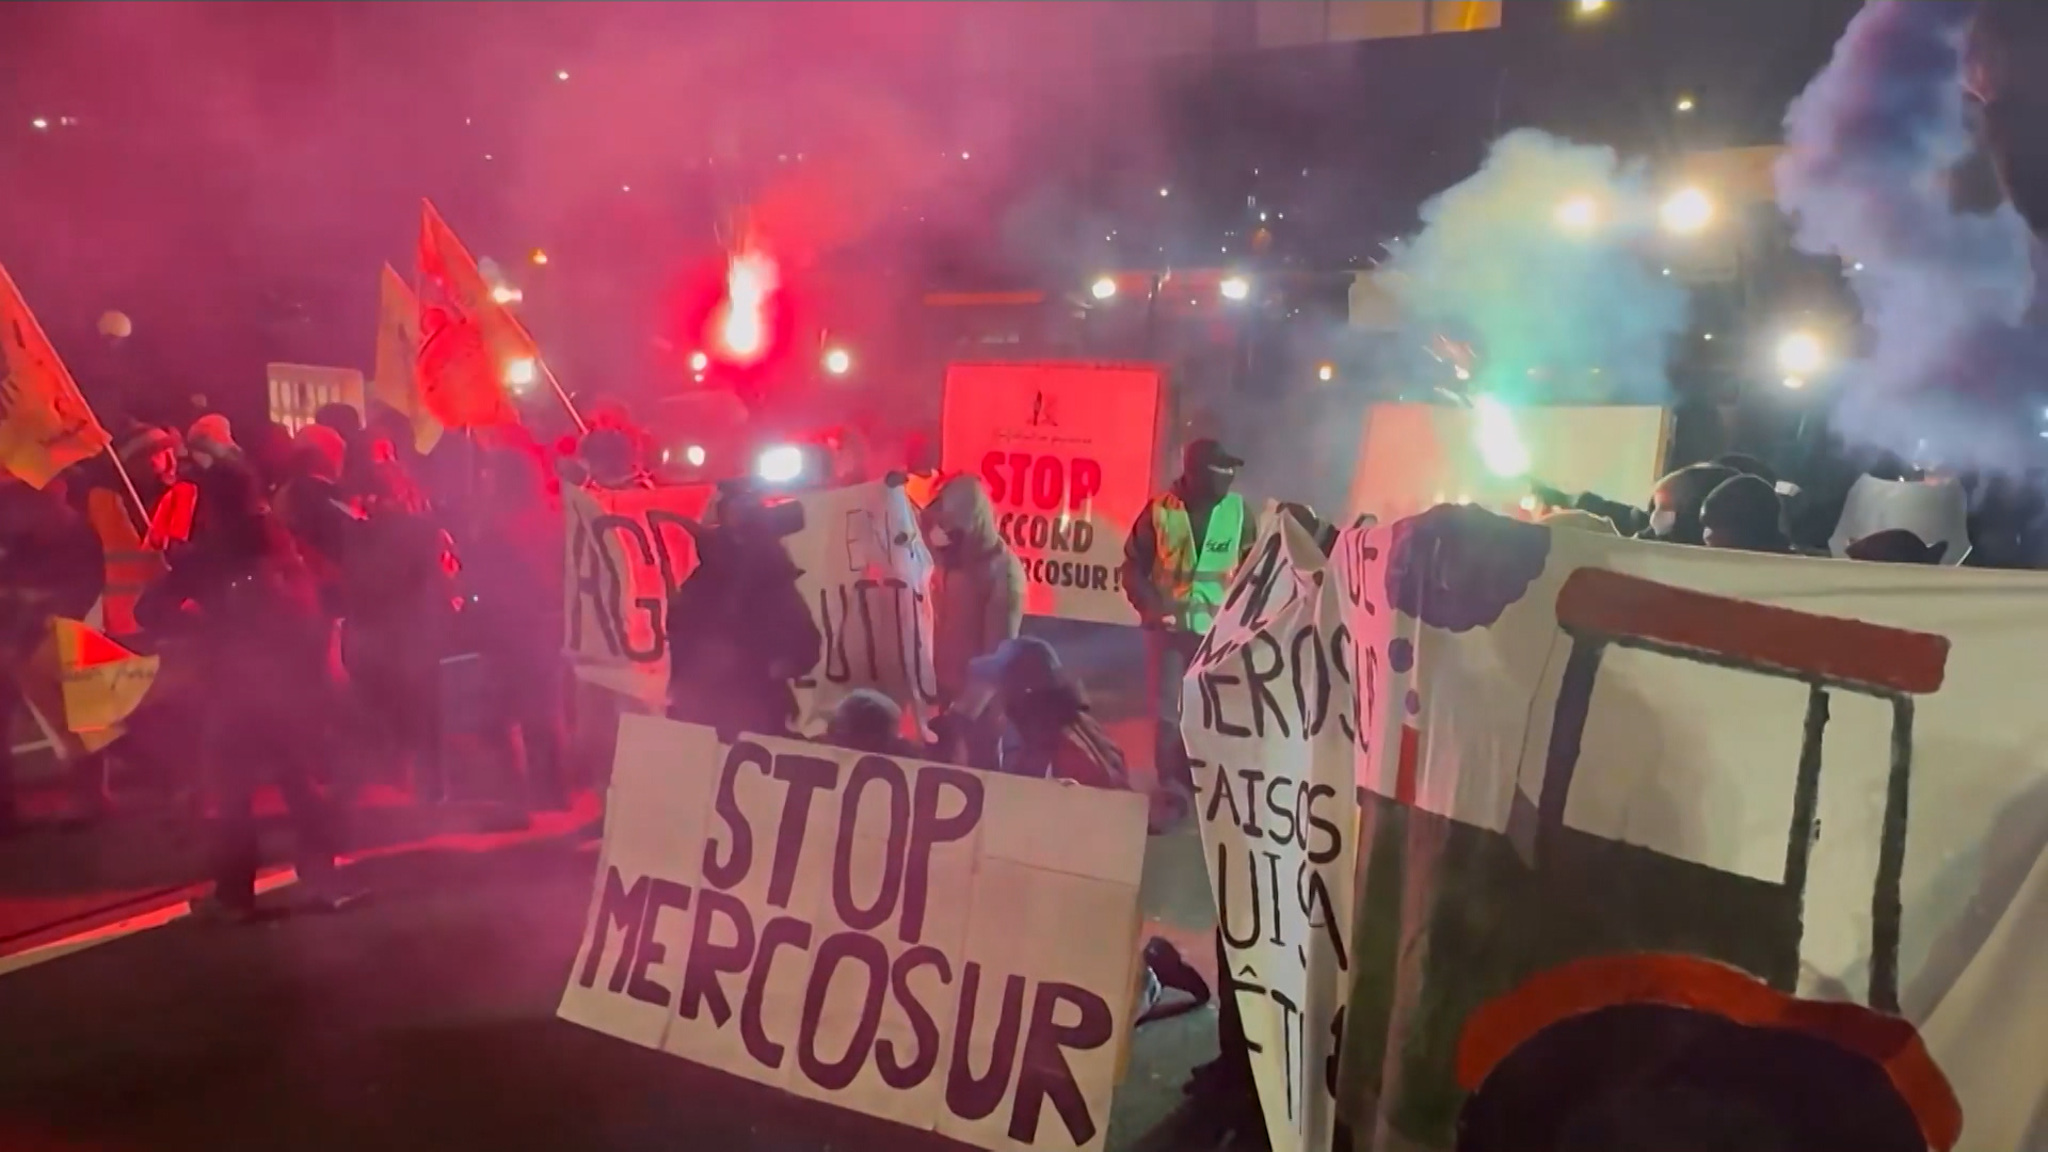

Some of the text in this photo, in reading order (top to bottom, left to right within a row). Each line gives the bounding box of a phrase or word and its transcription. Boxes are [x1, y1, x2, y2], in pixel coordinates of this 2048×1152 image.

[981, 451, 1102, 511] STOP
[999, 512, 1093, 553] CCORD
[1019, 557, 1108, 591] RCOSUR
[702, 741, 985, 944] STOP
[579, 865, 1113, 1147] MERCOSUR
